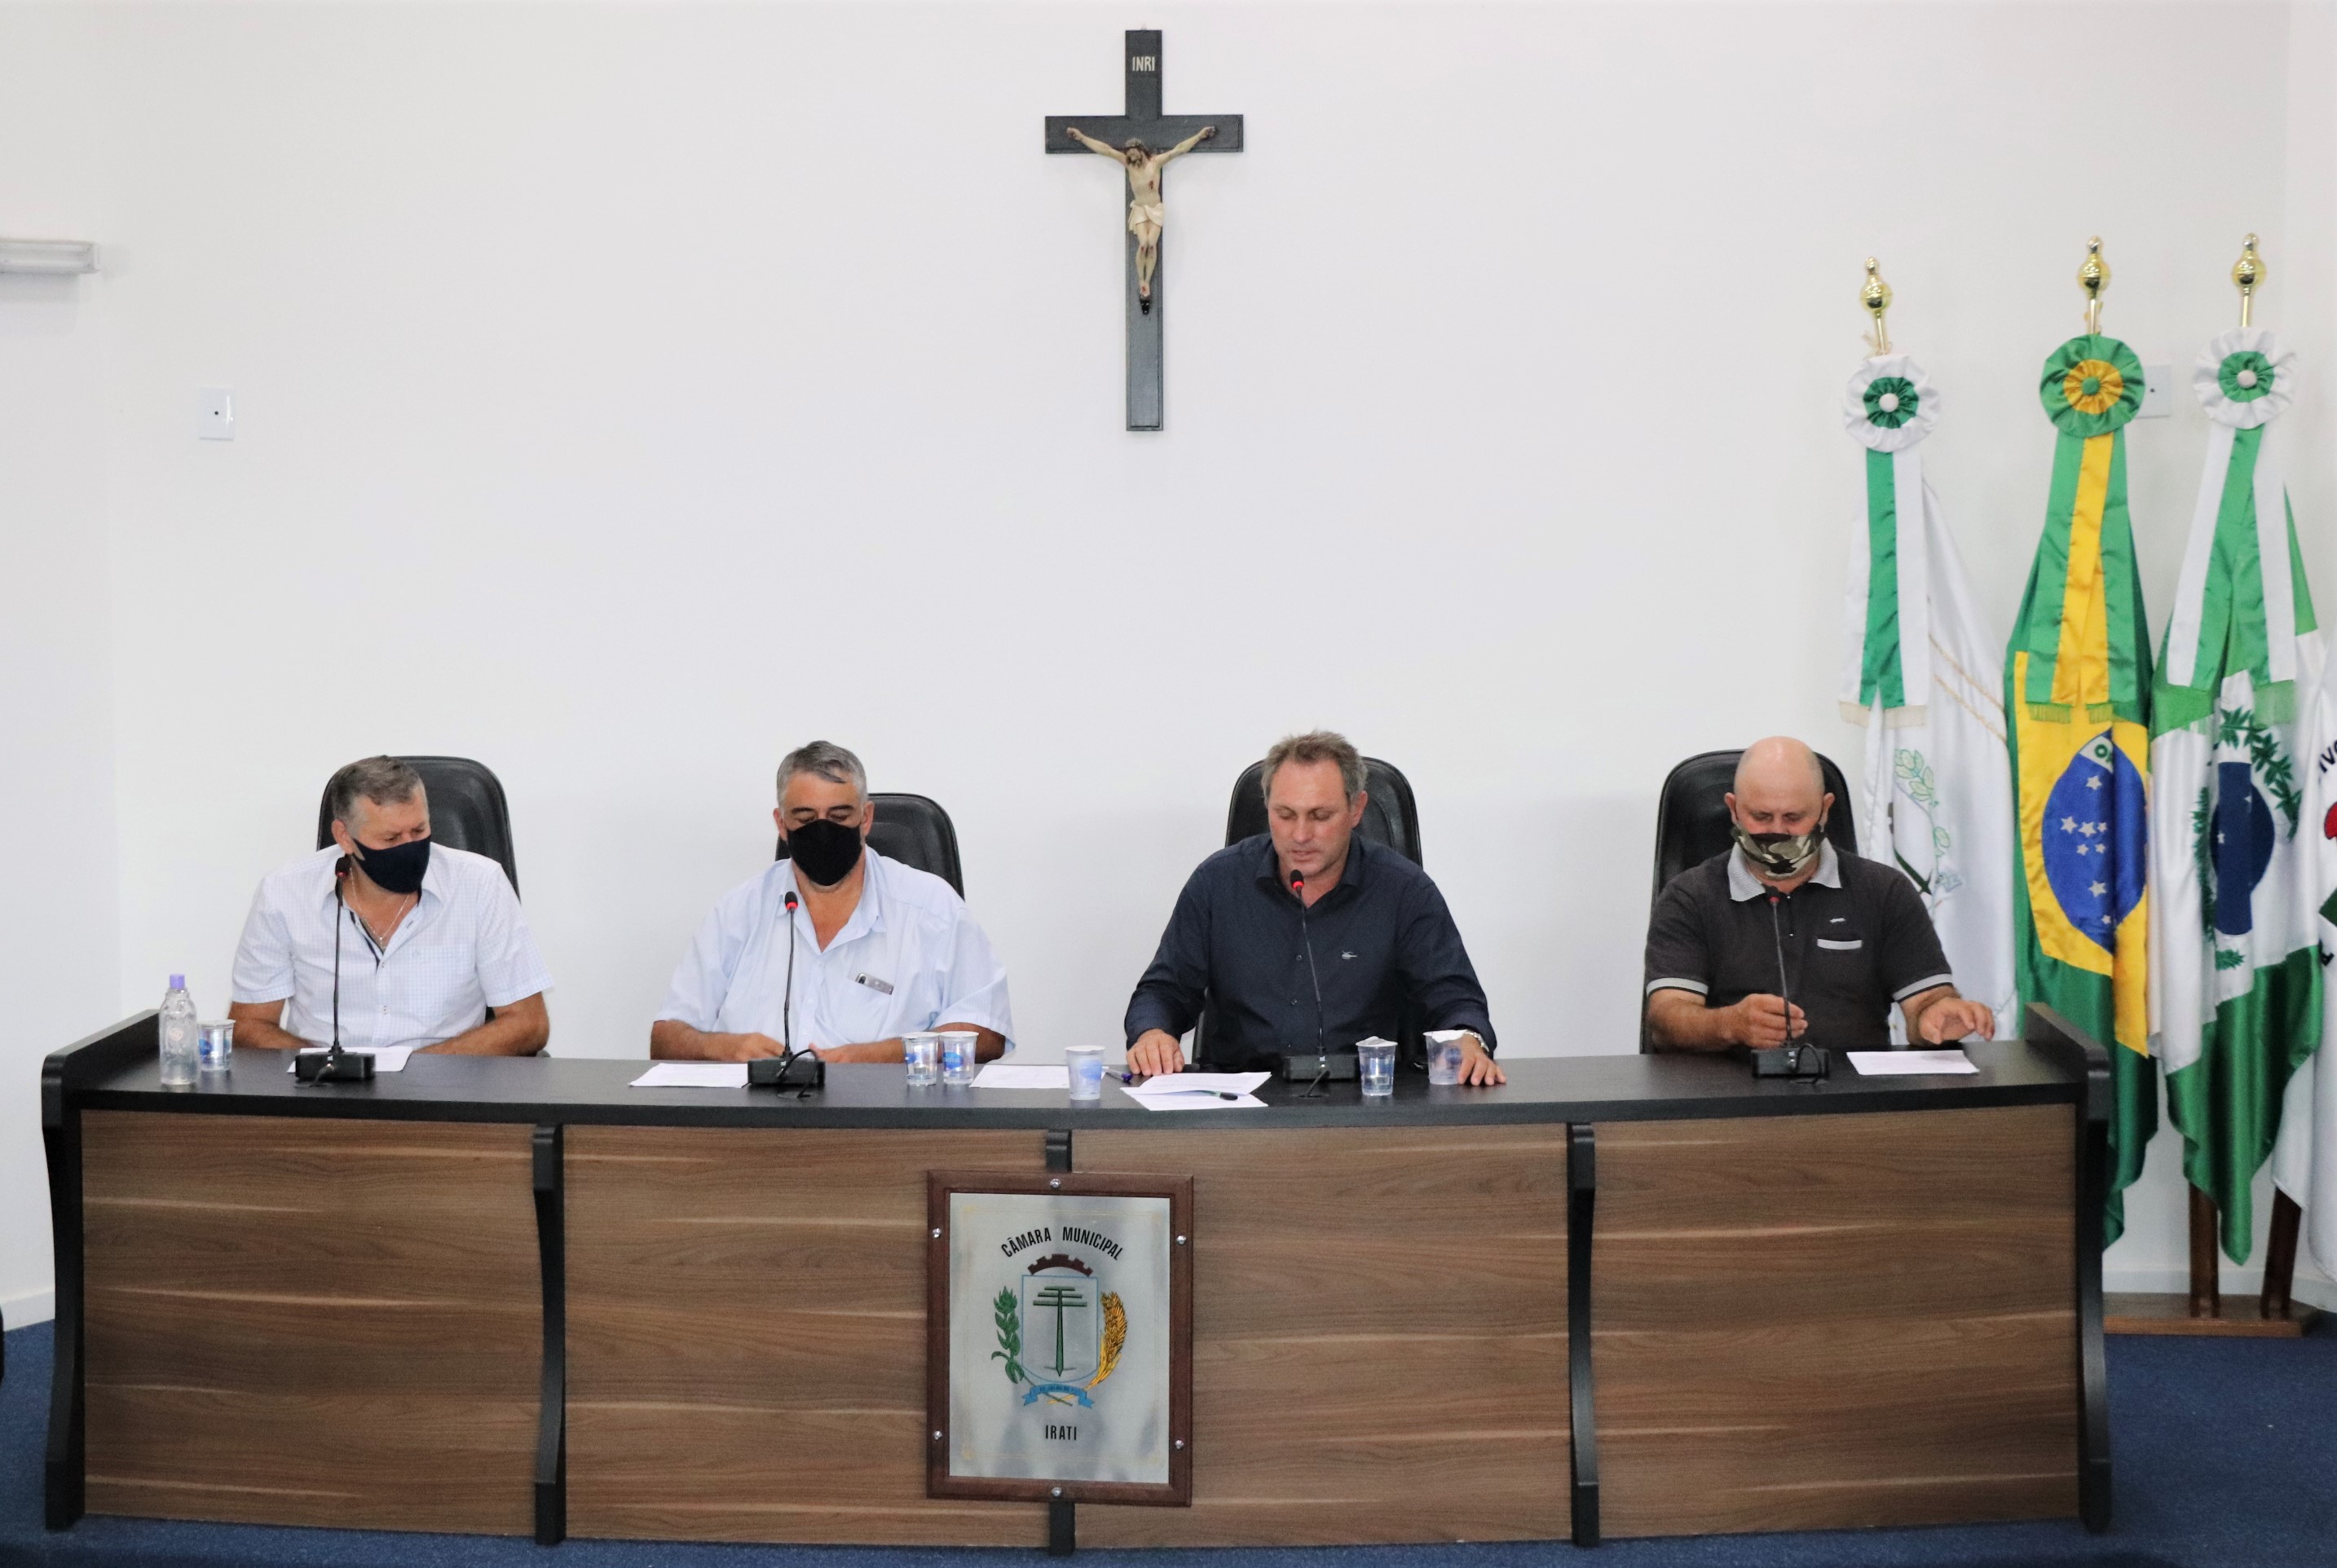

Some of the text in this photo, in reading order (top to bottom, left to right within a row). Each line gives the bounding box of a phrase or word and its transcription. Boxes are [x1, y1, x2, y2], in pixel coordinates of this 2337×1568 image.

[1132, 56, 1155, 72] INRI
[1001, 1227, 1123, 1261] CÂMARA MUNICIPAL
[1045, 1425, 1077, 1441] IRATI
